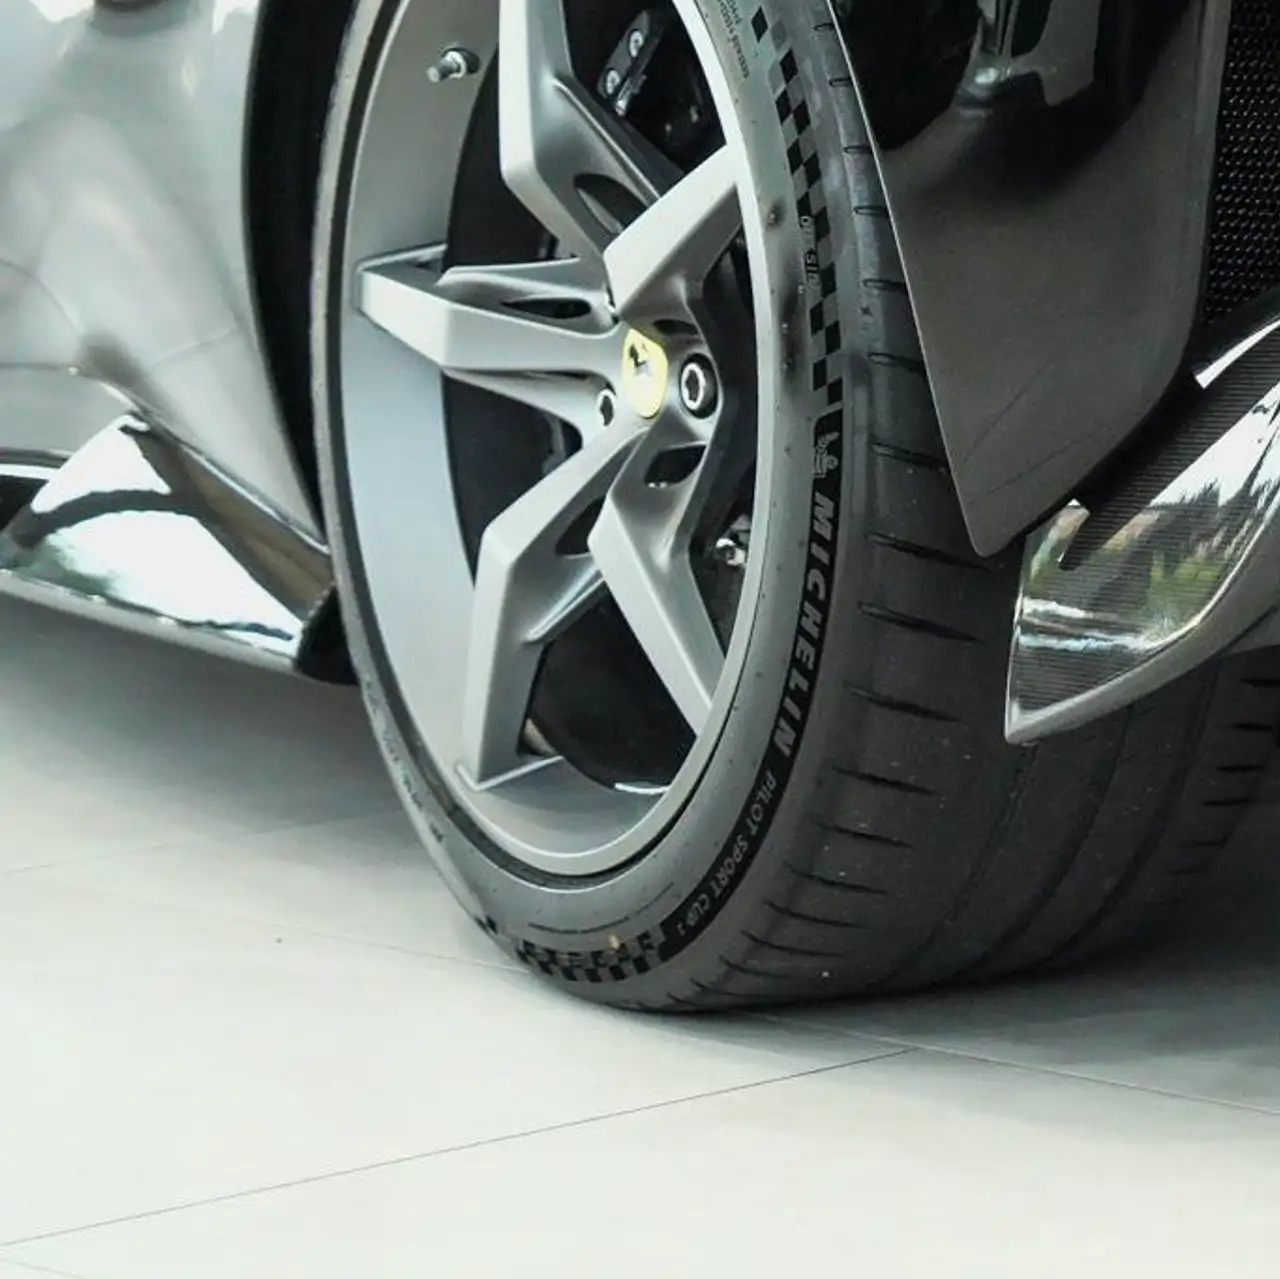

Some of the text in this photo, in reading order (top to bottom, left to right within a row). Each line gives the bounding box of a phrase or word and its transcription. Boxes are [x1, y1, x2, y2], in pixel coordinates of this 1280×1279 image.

[773, 490, 835, 758] MICHELIN
[745, 771, 777, 836] PILOT
[709, 834, 749, 898] SPORT
